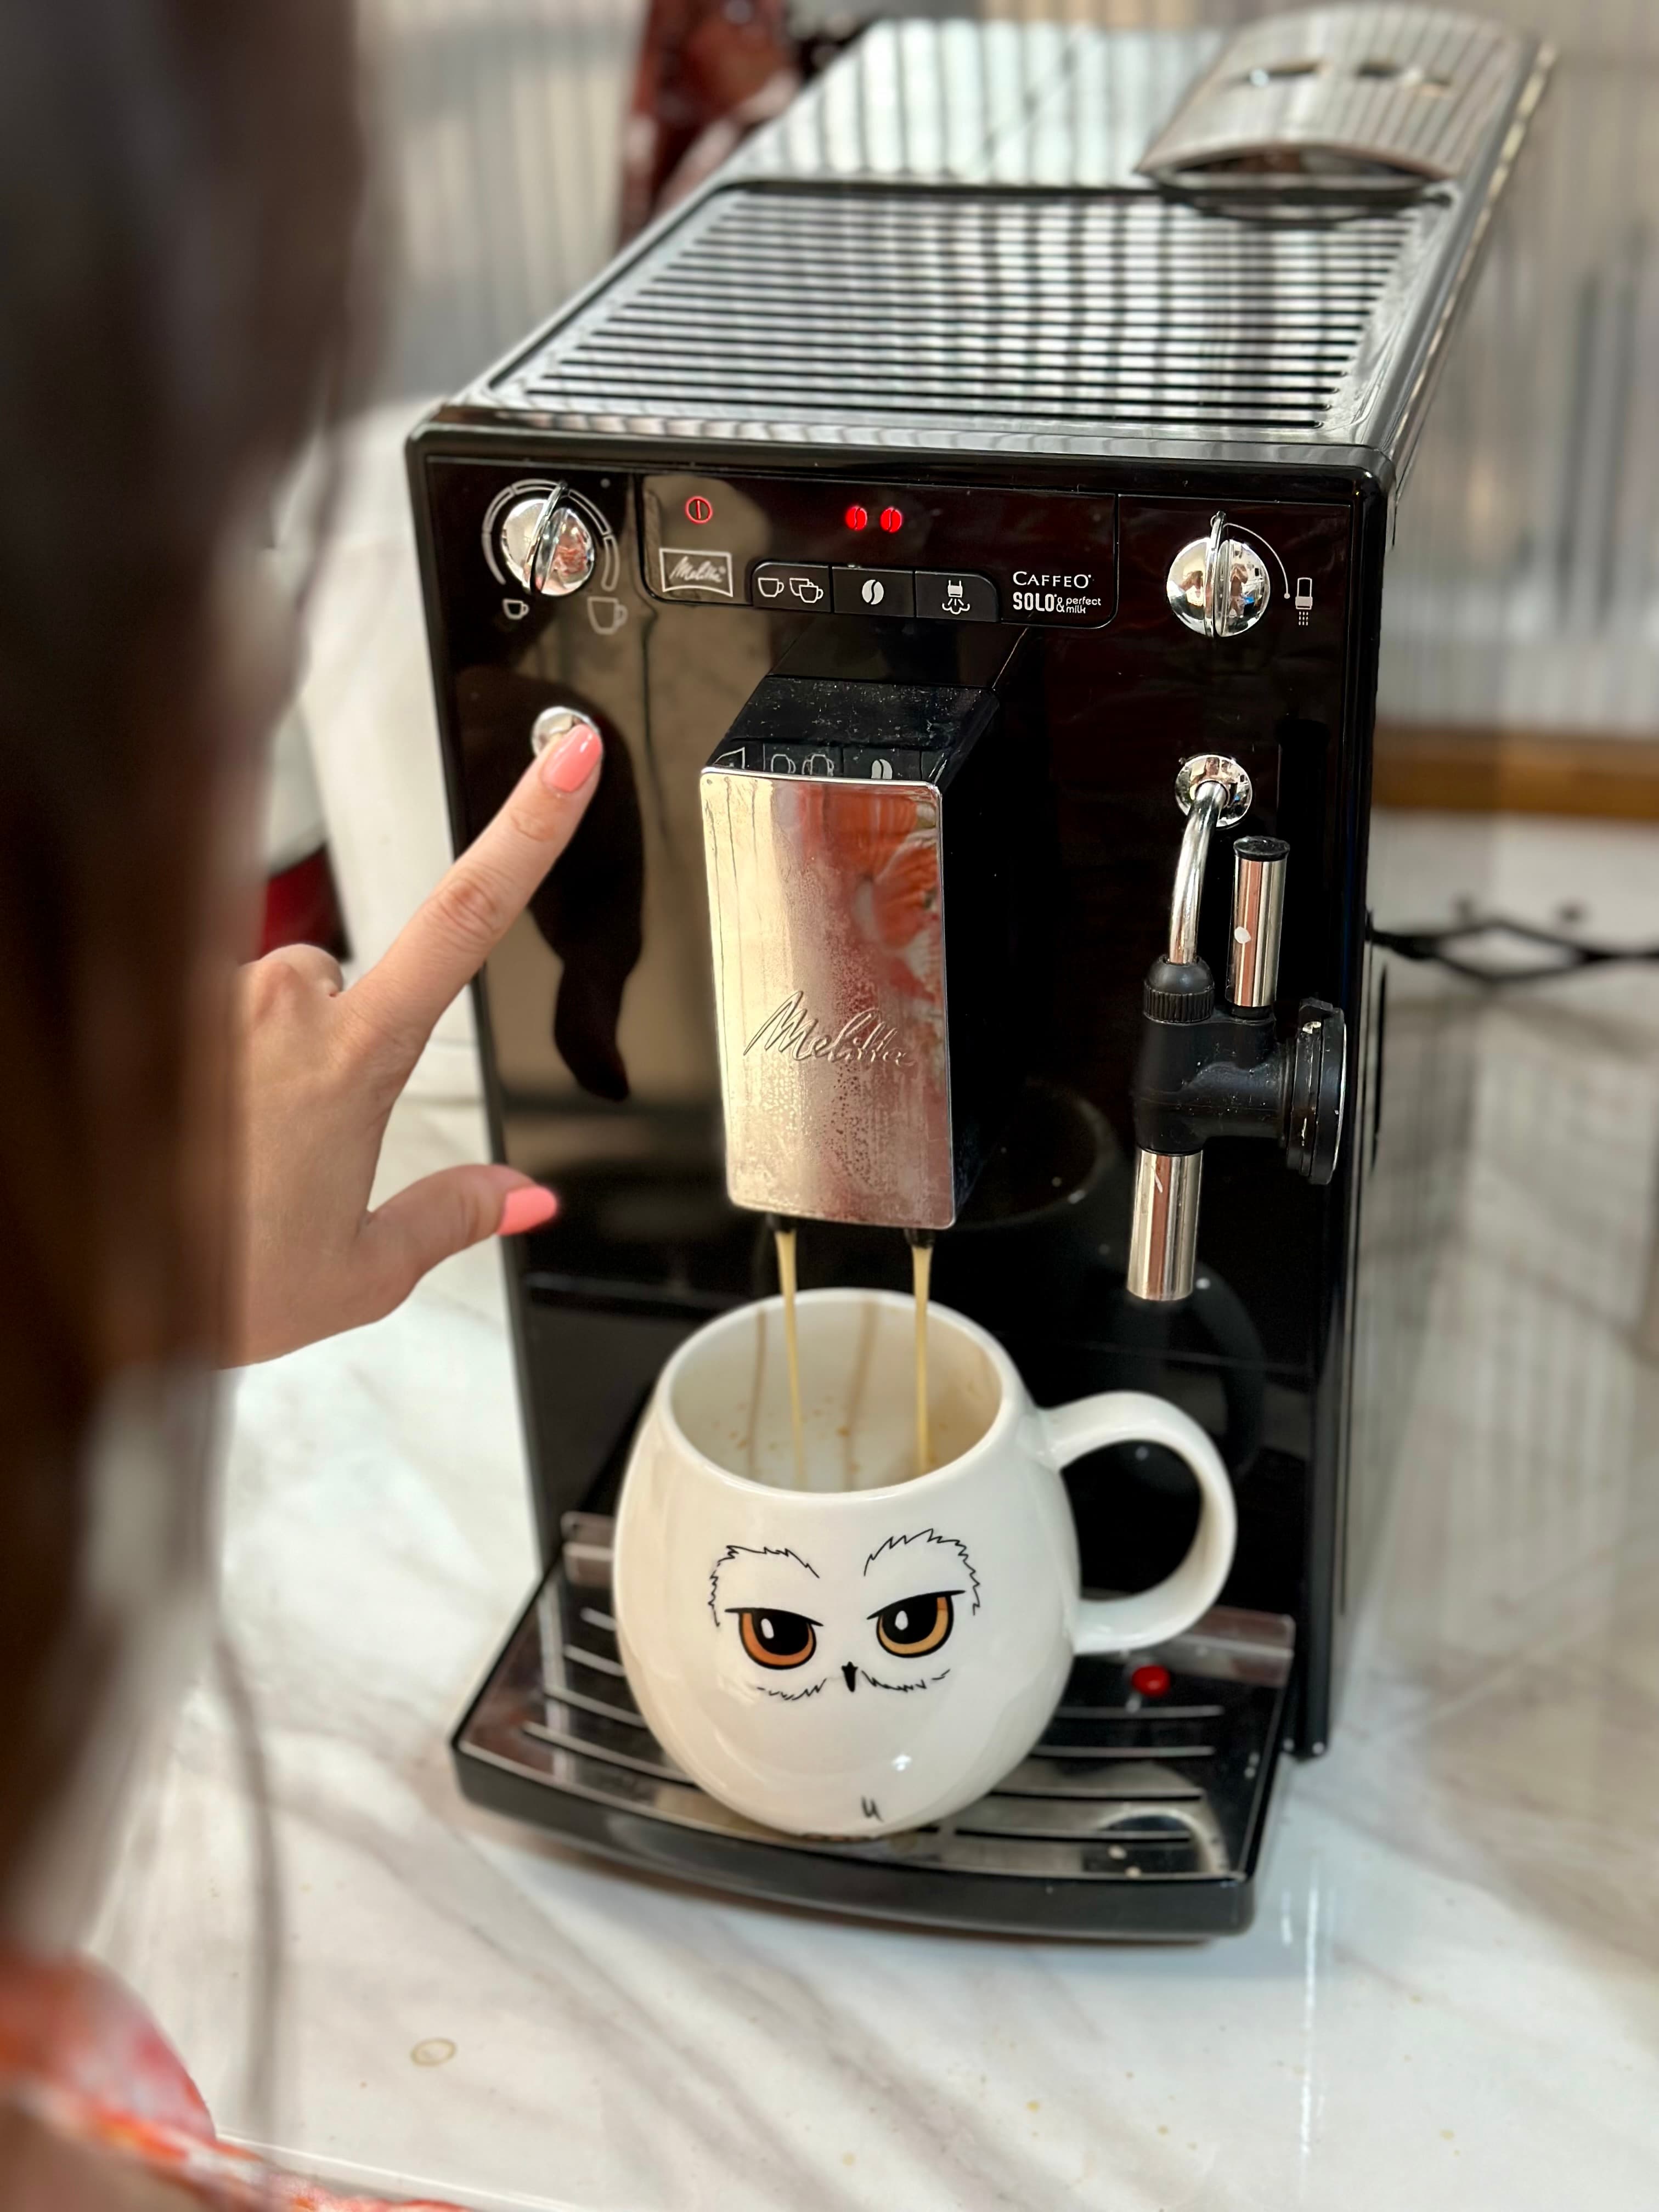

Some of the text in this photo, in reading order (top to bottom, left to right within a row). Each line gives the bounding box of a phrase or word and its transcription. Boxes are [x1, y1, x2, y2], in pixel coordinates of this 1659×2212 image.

[1013, 571, 1090, 589] CAFFEO
[1013, 591, 1102, 613] SOLO & perfect
[1066, 605, 1086, 614] milk
[742, 990, 917, 1066] Melitta
